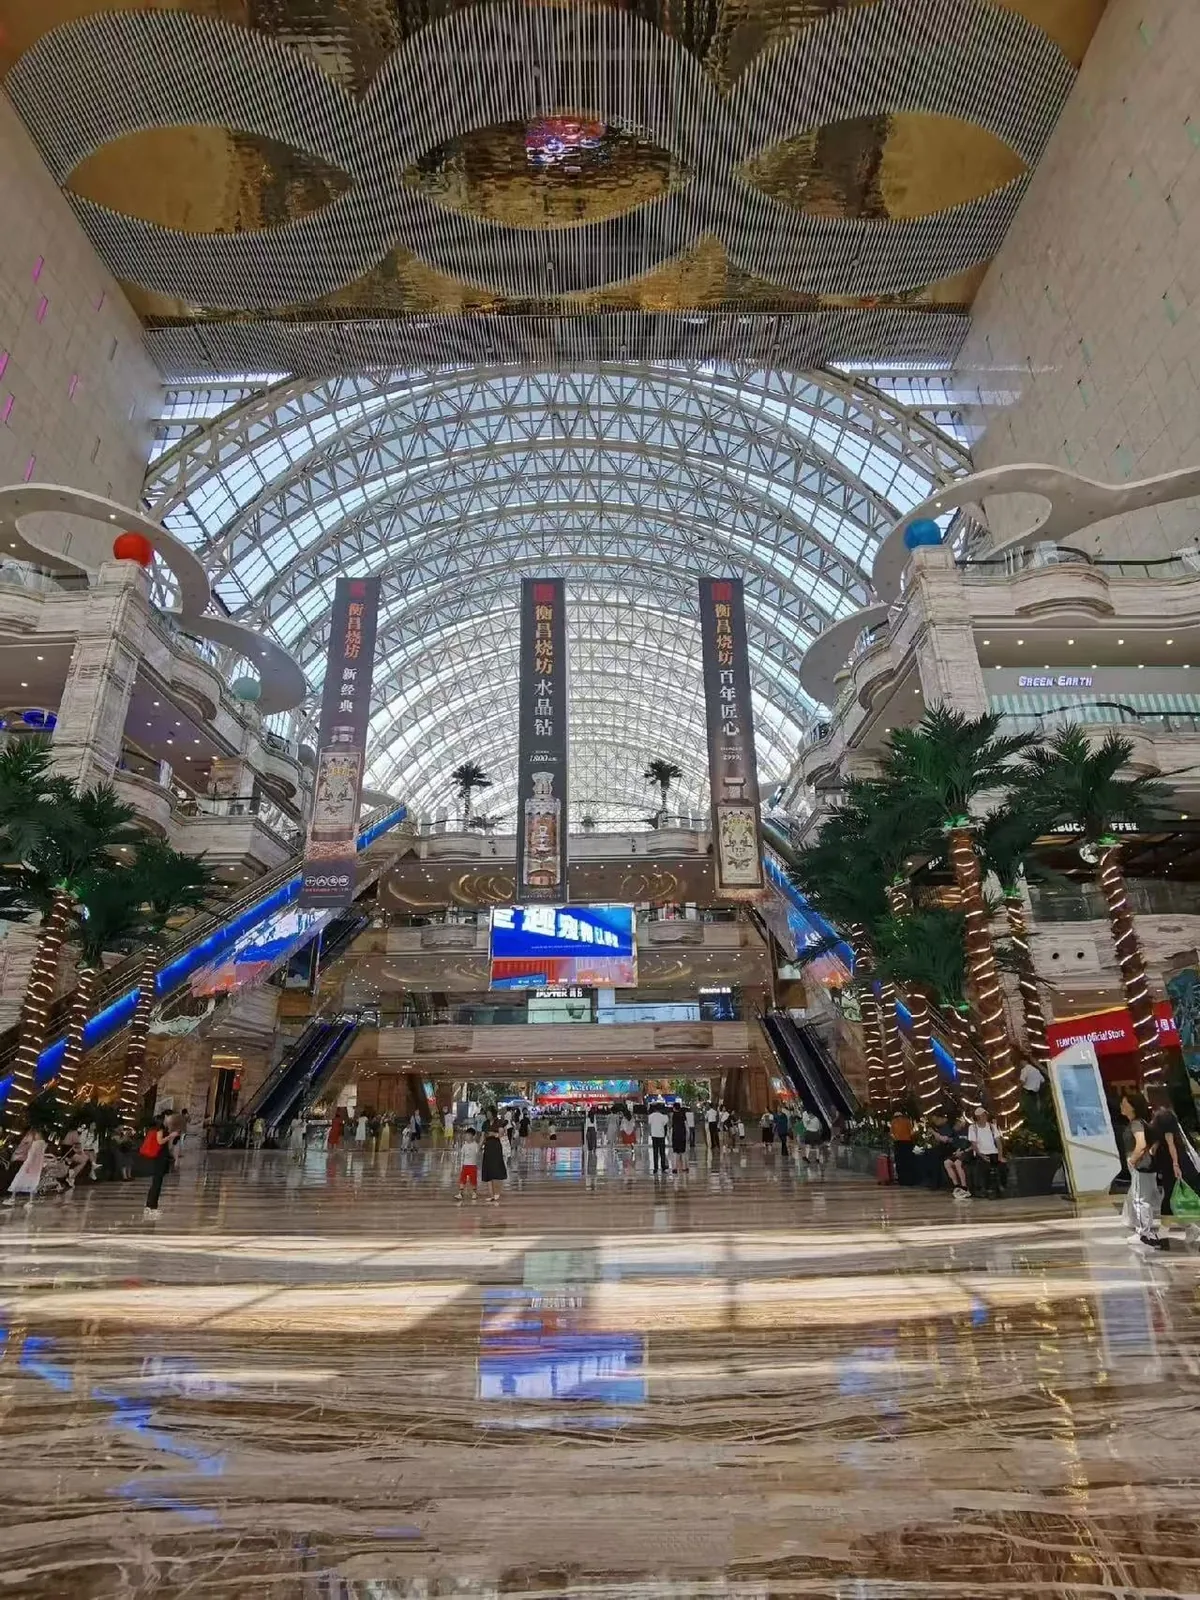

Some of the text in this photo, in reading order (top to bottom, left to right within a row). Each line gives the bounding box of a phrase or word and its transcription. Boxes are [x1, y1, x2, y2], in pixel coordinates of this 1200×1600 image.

[534, 604, 553, 675] 衡昌烧坊
[714, 603, 733, 666] 衡昌烧坊
[338, 667, 357, 713] 新经典
[533, 679, 553, 736] 水晶钻
[719, 669, 740, 736] 百年匠心
[1018, 675, 1093, 687] GREEN EARTH
[1108, 1029, 1125, 1040] Store
